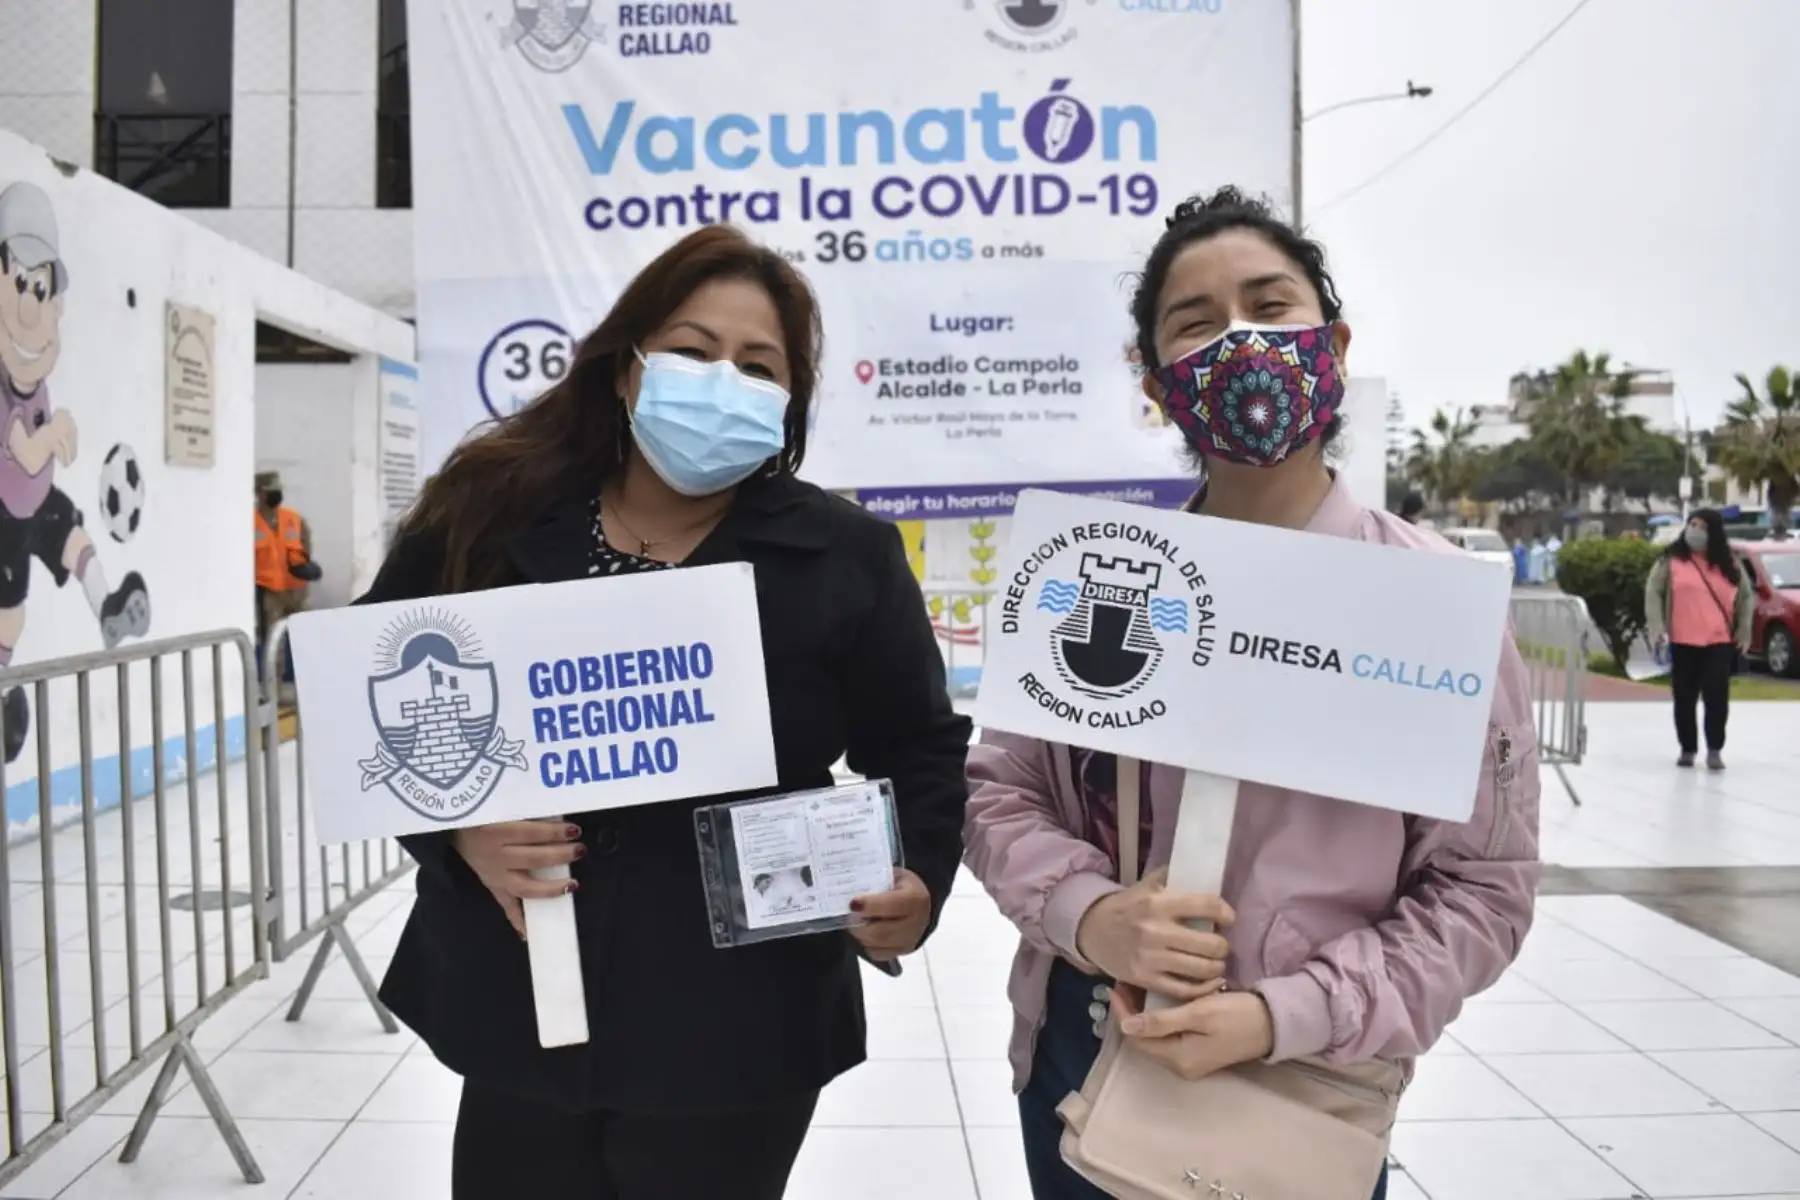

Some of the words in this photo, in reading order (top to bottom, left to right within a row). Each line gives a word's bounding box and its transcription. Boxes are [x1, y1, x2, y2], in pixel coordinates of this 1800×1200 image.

[619, 3, 738, 27] REGIONAL
[620, 31, 711, 57] CALLAO
[561, 78, 1158, 175] Vacunatón
[584, 184, 780, 231] contra
[801, 177, 851, 220] la
[872, 174, 1158, 220] COVID-19
[815, 230, 867, 263] 36
[875, 229, 974, 262] años
[981, 246, 995, 259] a
[1001, 240, 1045, 258] más
[929, 313, 1014, 337] Lugar:
[504, 341, 567, 381] 36
[878, 355, 968, 377] Estadio
[975, 354, 1079, 376] Campolo
[876, 379, 967, 399] Alcalde
[989, 380, 1016, 396] La
[1023, 377, 1083, 395] Perla
[865, 495, 920, 514] elegir
[923, 495, 944, 510] tu
[947, 491, 1017, 509] horario
[1072, 522, 1182, 563] REGIONAL
[1002, 533, 1068, 634] DIRECCION
[1085, 583, 1147, 606] DIRESA
[1179, 561, 1206, 591] DE
[1191, 593, 1216, 667] SALUD
[528, 641, 714, 699] GOBIERNO
[1229, 631, 1343, 673] DIRESA
[1351, 653, 1482, 697] CALLAO
[532, 688, 715, 743] REGIONAL
[1018, 672, 1083, 724] REGION
[1087, 698, 1167, 729] CALLAO
[539, 736, 678, 788] CALLAO
[399, 772, 445, 810] REGIÓN
[450, 764, 493, 809] CALLAO
